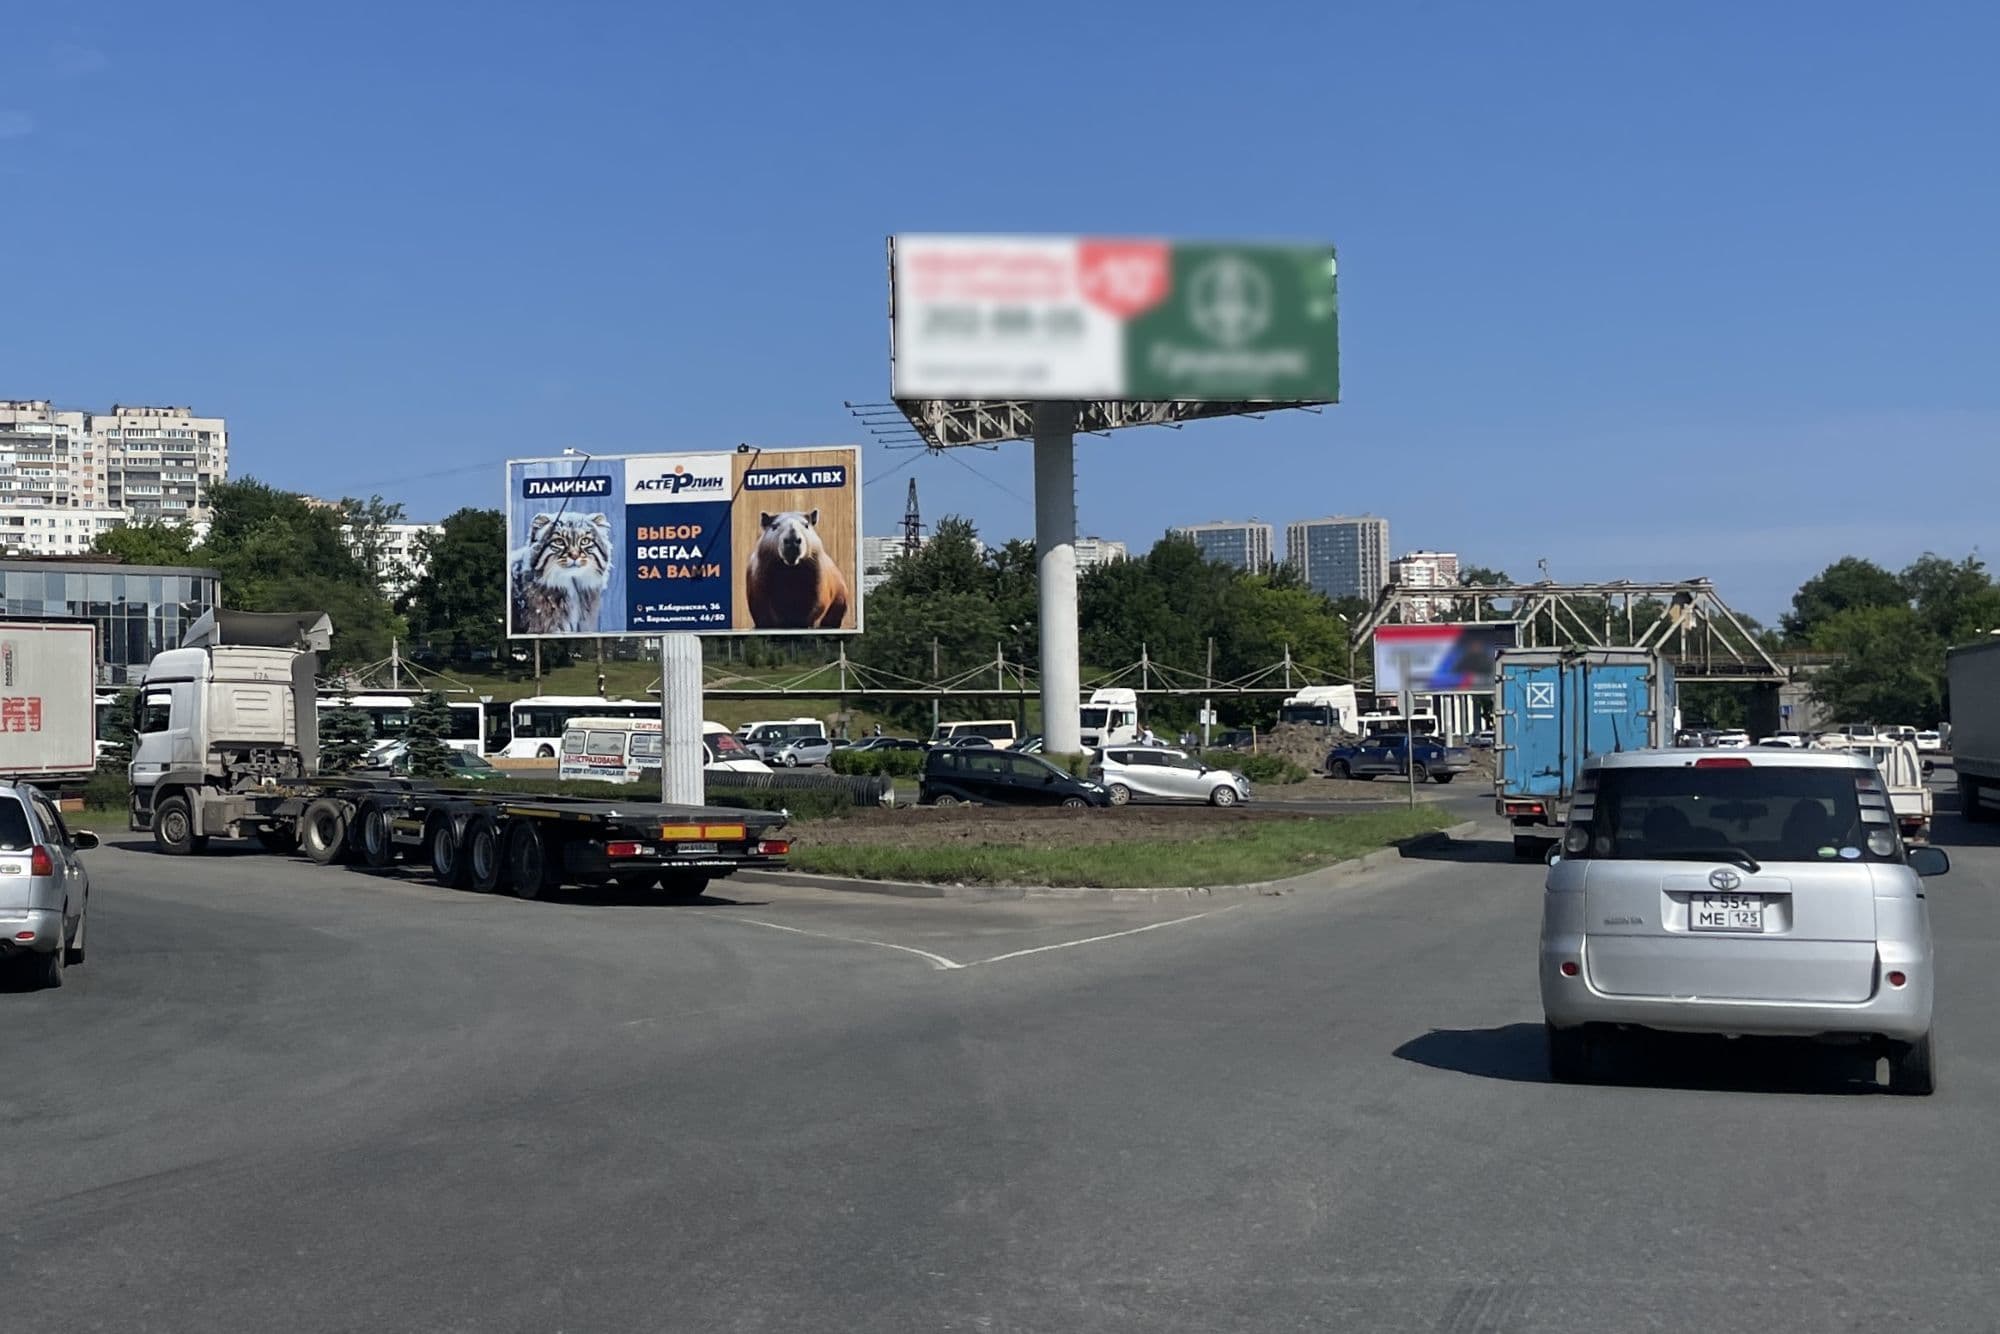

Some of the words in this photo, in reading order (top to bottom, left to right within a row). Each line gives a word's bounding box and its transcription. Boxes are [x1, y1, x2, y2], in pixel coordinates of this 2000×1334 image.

[747, 472, 808, 486] ПЛИТКА
[812, 471, 842, 484] ПВХ
[529, 480, 606, 494] ЛАМИНАТ
[637, 525, 702, 540] ВЫБОР
[637, 545, 703, 560] ВСЕГДА
[637, 565, 662, 579] ЗА
[667, 563, 720, 578] ВАМИ
[1720, 896, 1750, 909] 554
[1700, 912, 1725, 926] МЕ
[1734, 912, 1758, 923] 125
